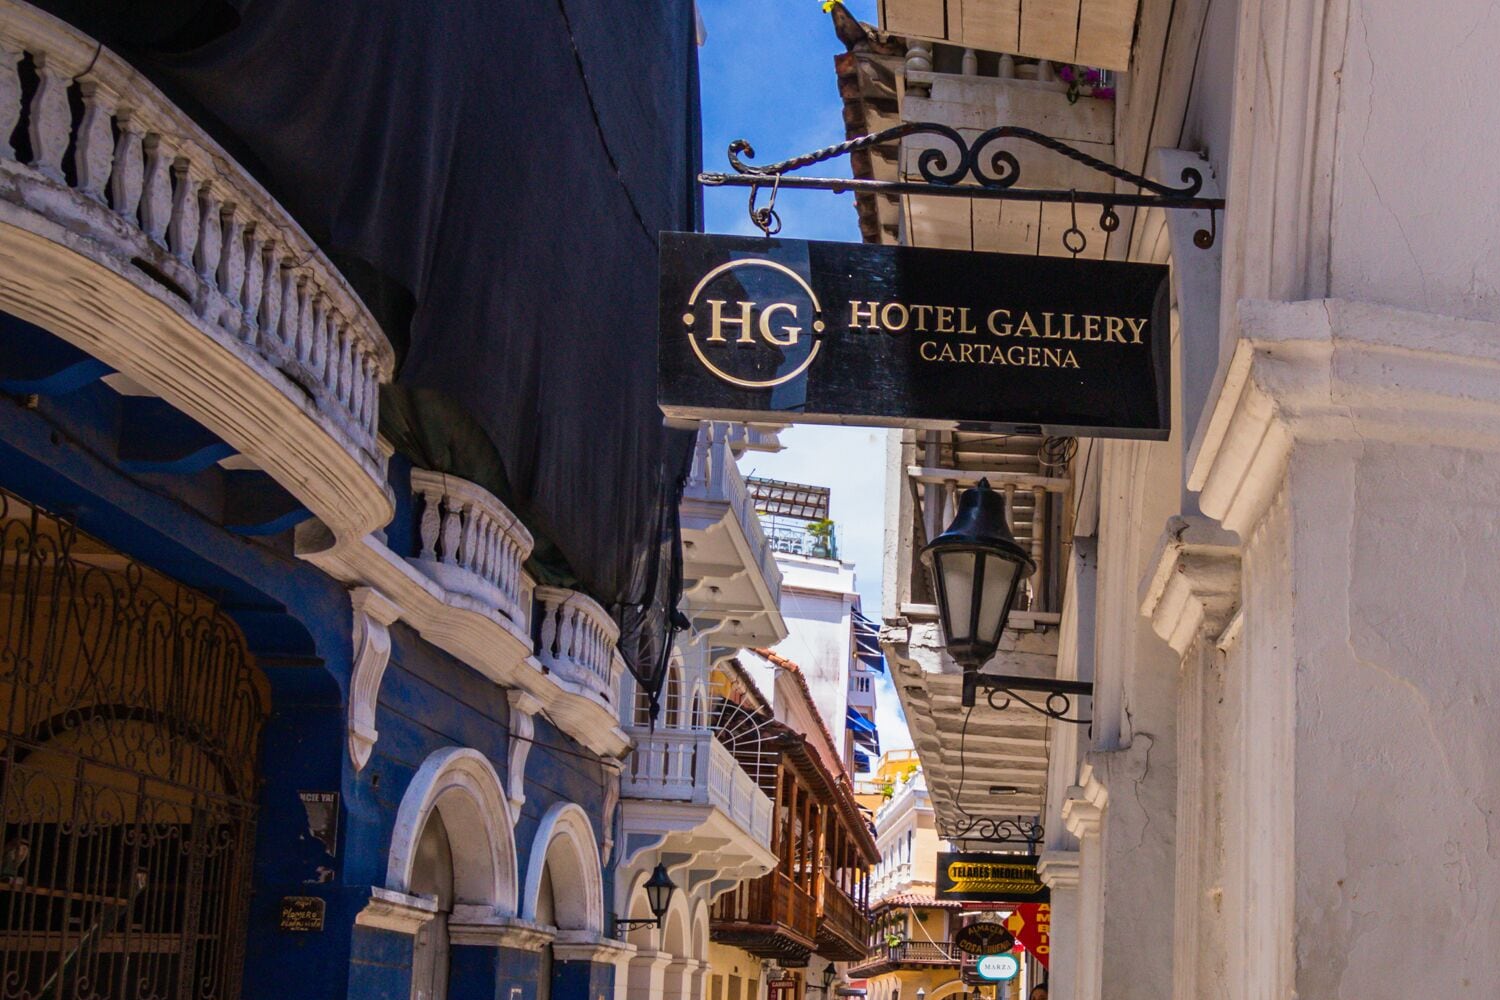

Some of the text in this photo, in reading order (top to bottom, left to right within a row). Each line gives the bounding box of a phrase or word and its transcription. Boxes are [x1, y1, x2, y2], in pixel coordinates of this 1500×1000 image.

[706, 299, 802, 346] HG
[848, 300, 1149, 345] HOTEL GALLERY
[919, 341, 1081, 369] CARTAGENA
[953, 866, 990, 878] TELARES
[1036, 904, 1050, 954] AMBIO
[959, 940, 982, 953] COSA
[984, 963, 1012, 971] MARZA
